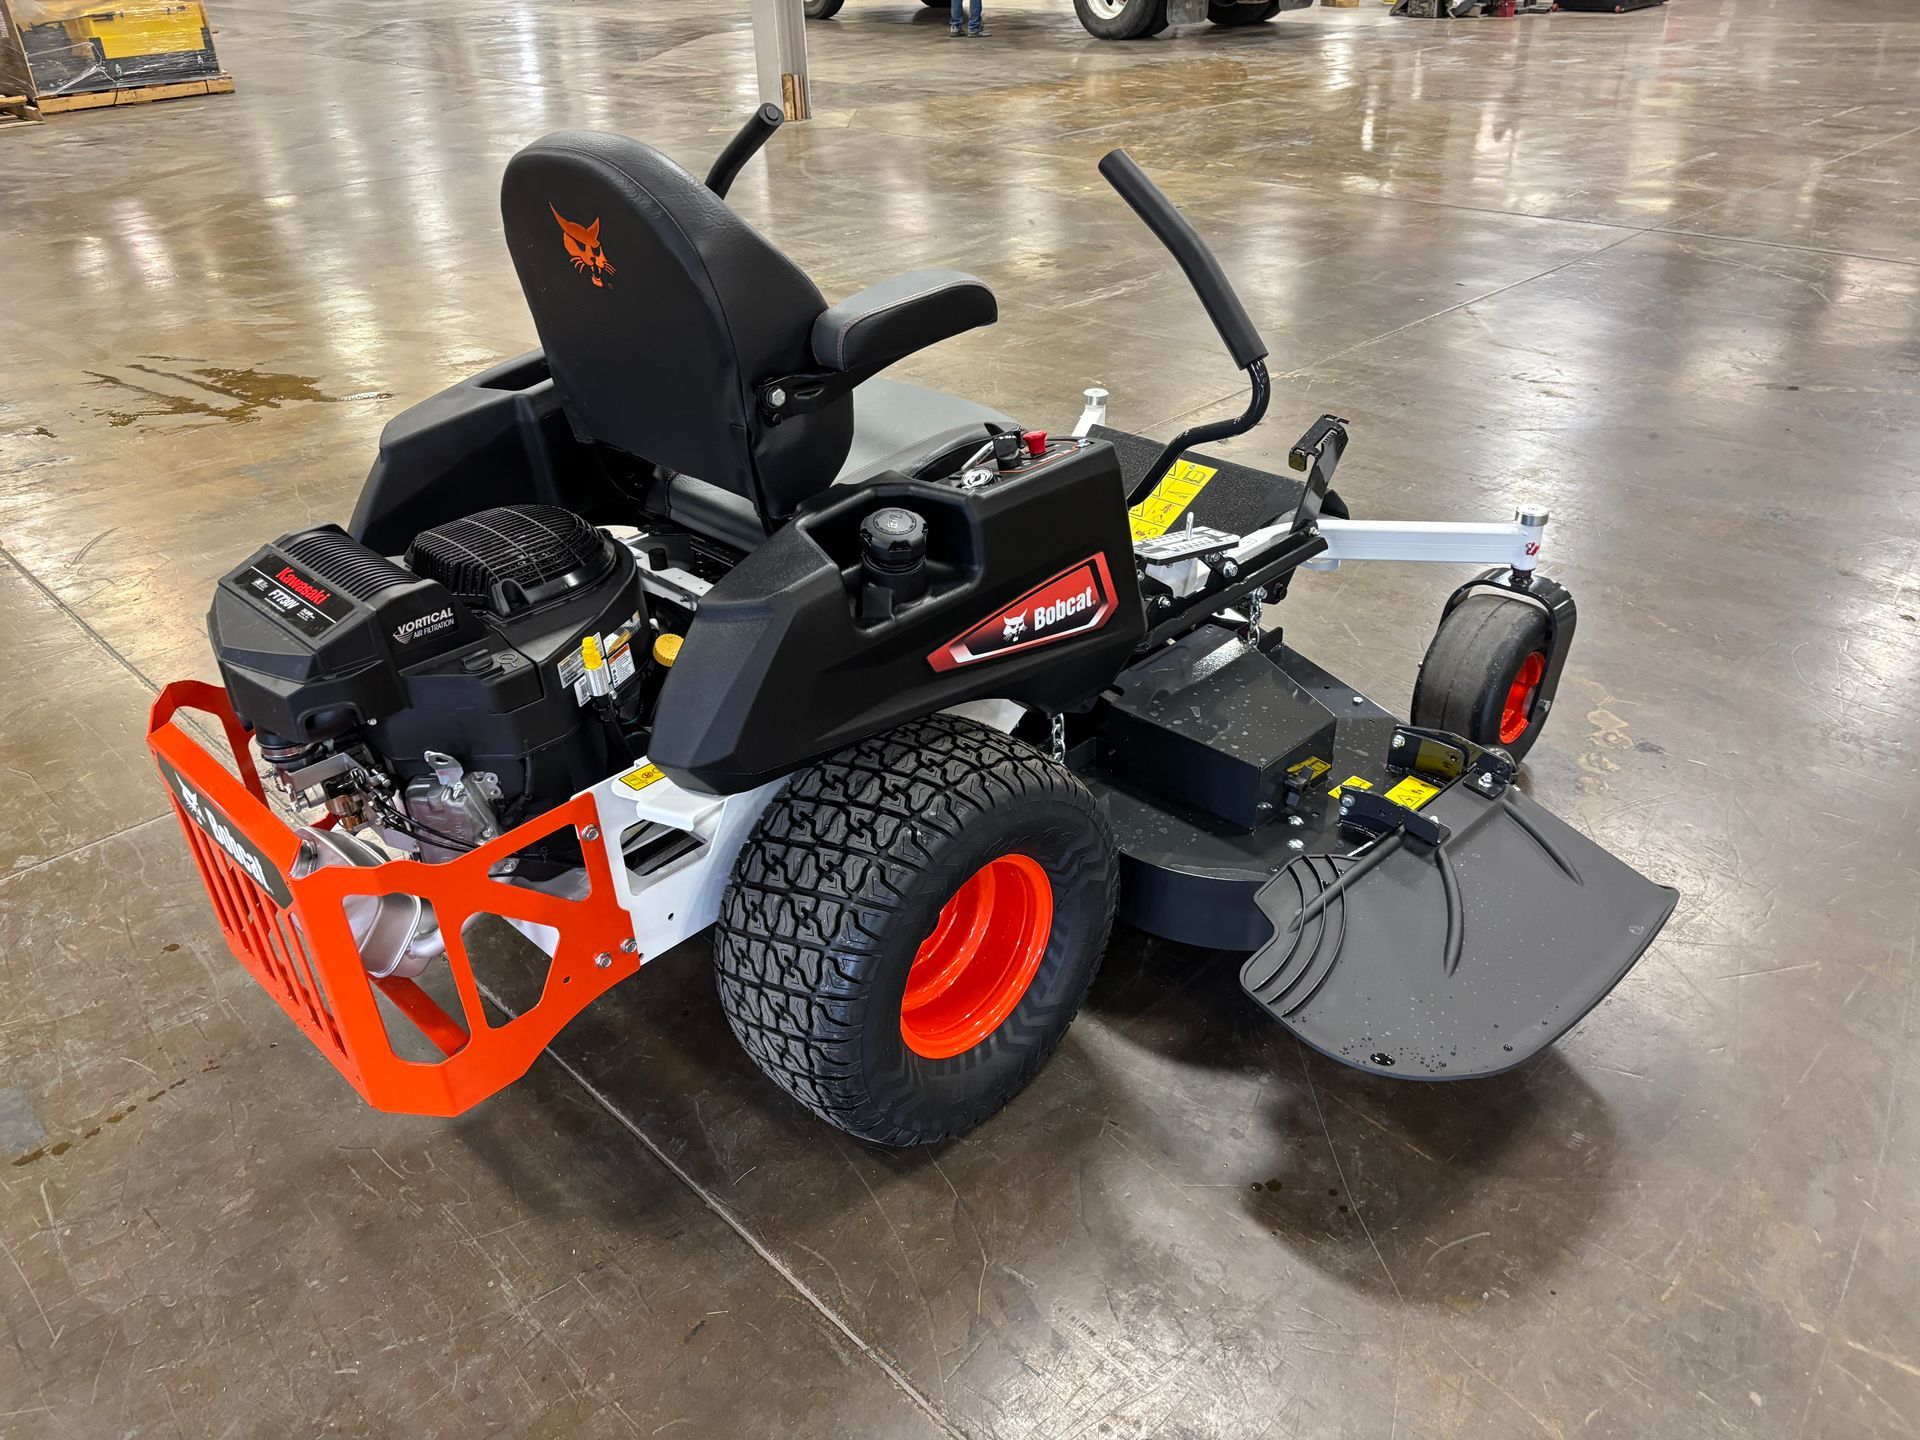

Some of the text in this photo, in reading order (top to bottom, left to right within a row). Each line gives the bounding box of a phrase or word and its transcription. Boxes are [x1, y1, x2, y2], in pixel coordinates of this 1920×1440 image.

[275, 567, 331, 605] Kawasaki
[397, 607, 454, 636] VORTICAL
[1034, 586, 1093, 631] Bobcat
[413, 618, 455, 639] AIR FILTRATION
